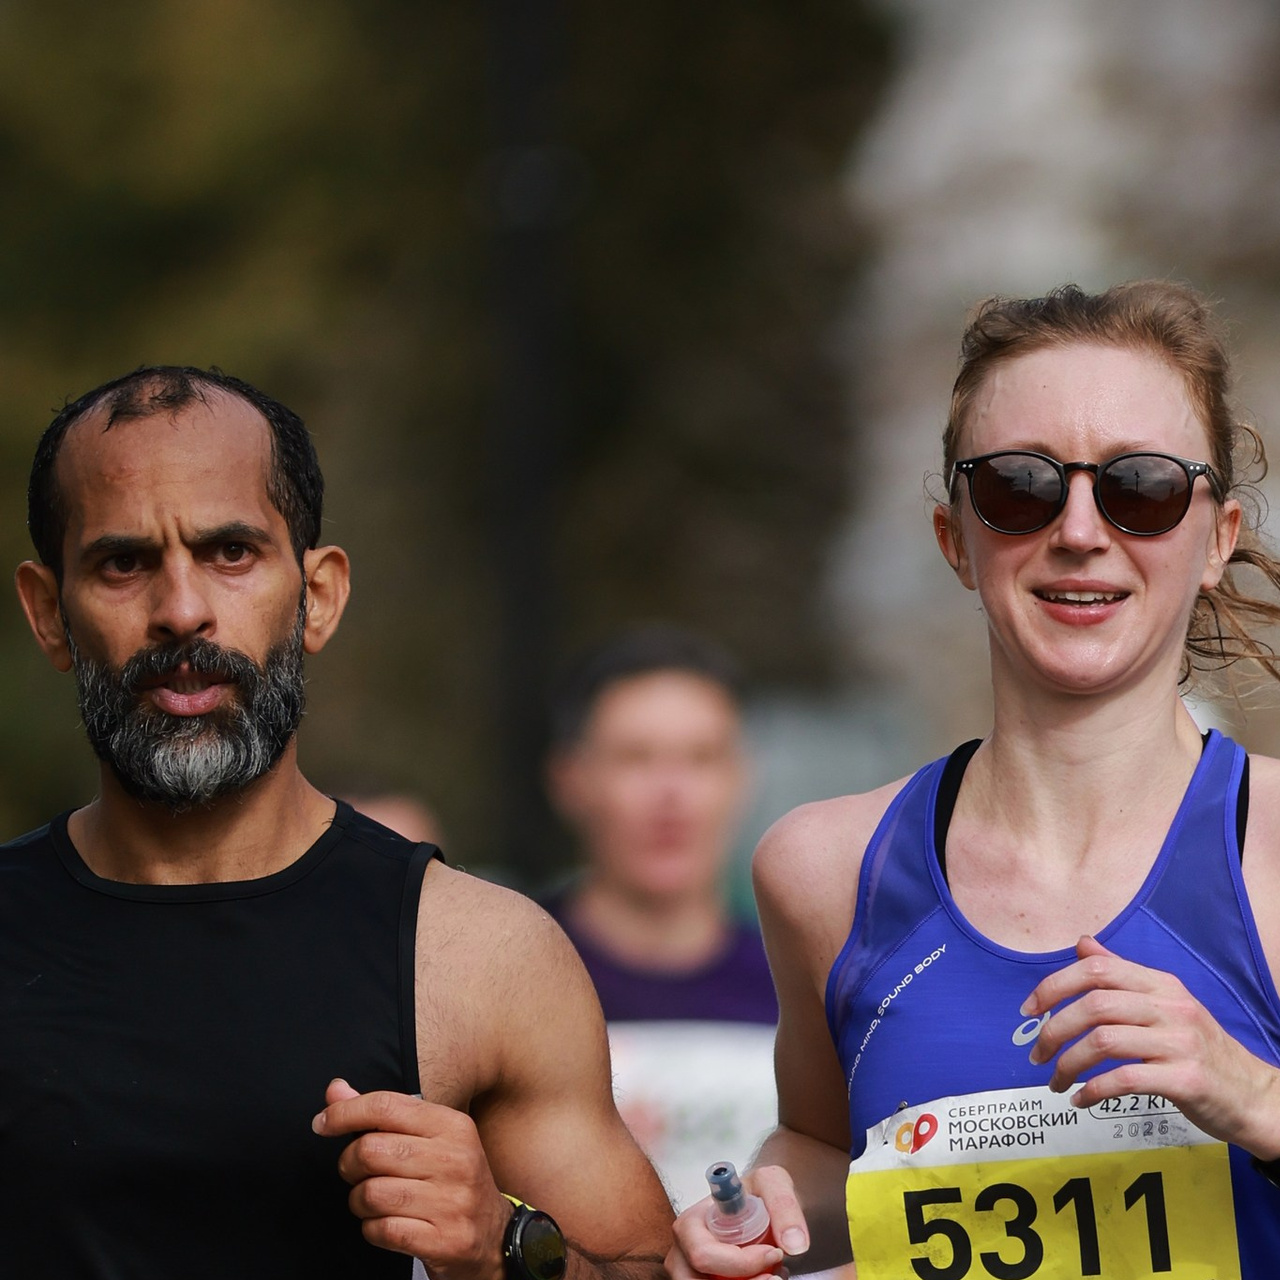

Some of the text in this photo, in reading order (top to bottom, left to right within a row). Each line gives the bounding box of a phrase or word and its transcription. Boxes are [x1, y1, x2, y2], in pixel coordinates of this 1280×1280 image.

[860, 1018, 881, 1051] MIND,
[878, 973, 913, 1016] SOUND
[914, 944, 947, 974] BODY
[948, 1099, 1043, 1118] СБЕРПРАЙМ
[1100, 1096, 1140, 1113] 42,2
[948, 1109, 1079, 1134] МОСКОВСКИЙ
[1113, 1120, 1169, 1138] 2026
[949, 1131, 1045, 1152] МАРАФОН
